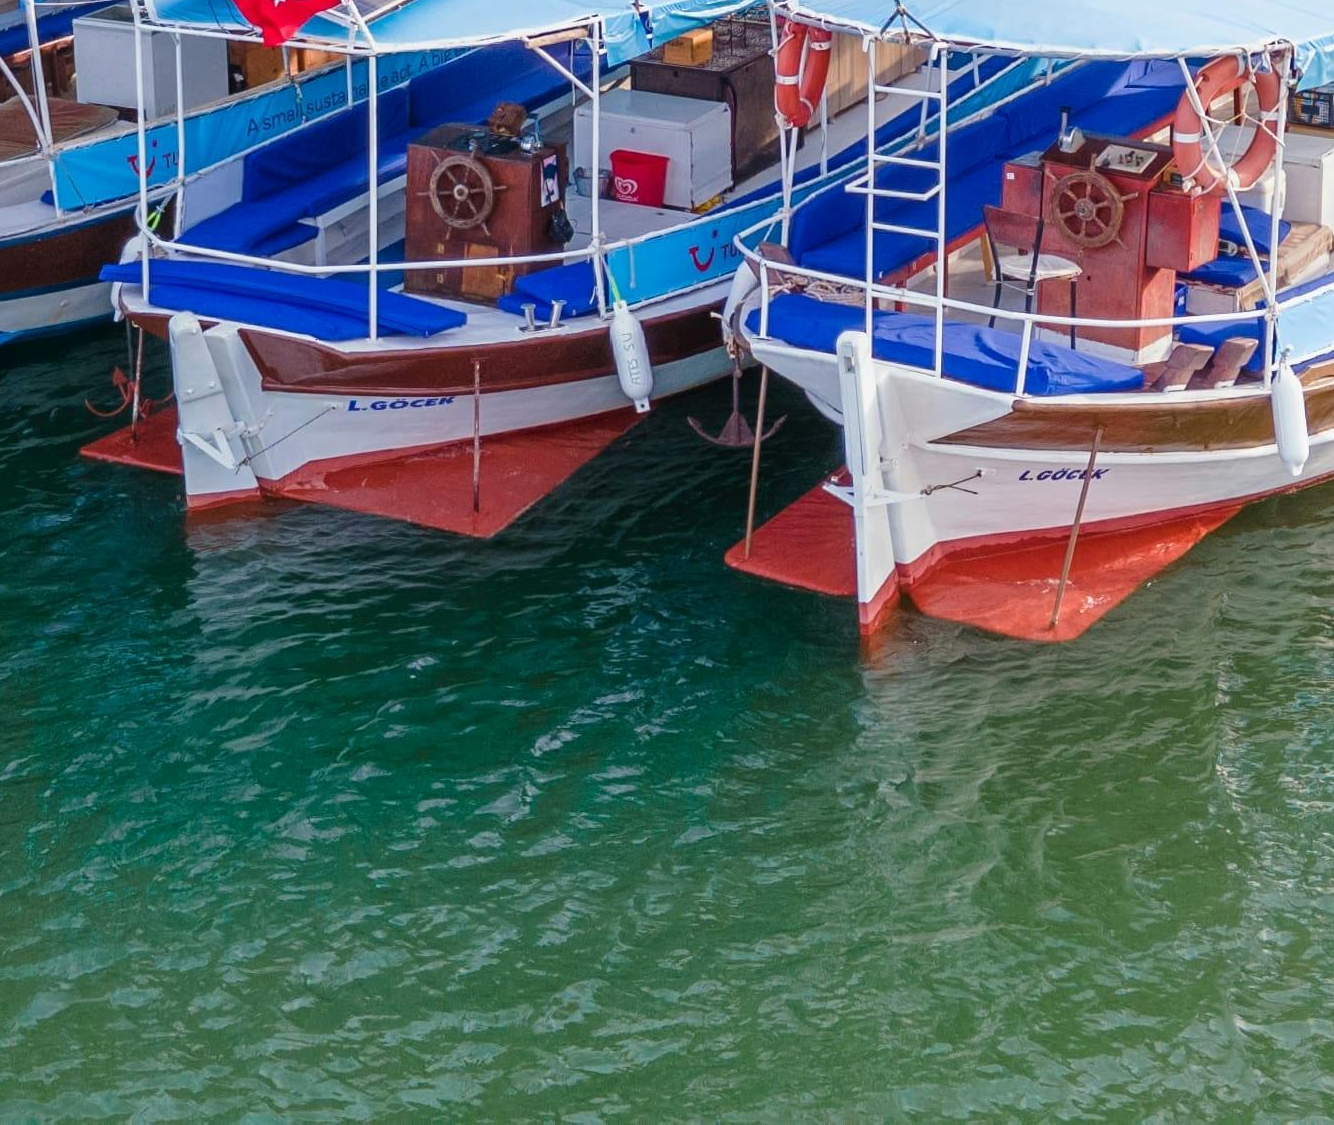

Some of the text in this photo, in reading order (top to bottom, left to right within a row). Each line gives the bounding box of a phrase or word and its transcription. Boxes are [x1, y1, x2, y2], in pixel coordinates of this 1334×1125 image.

[247, 117, 259, 137] A
[263, 101, 303, 131] small
[418, 54, 429, 73] A
[348, 396, 456, 412] L.GÖCEK
